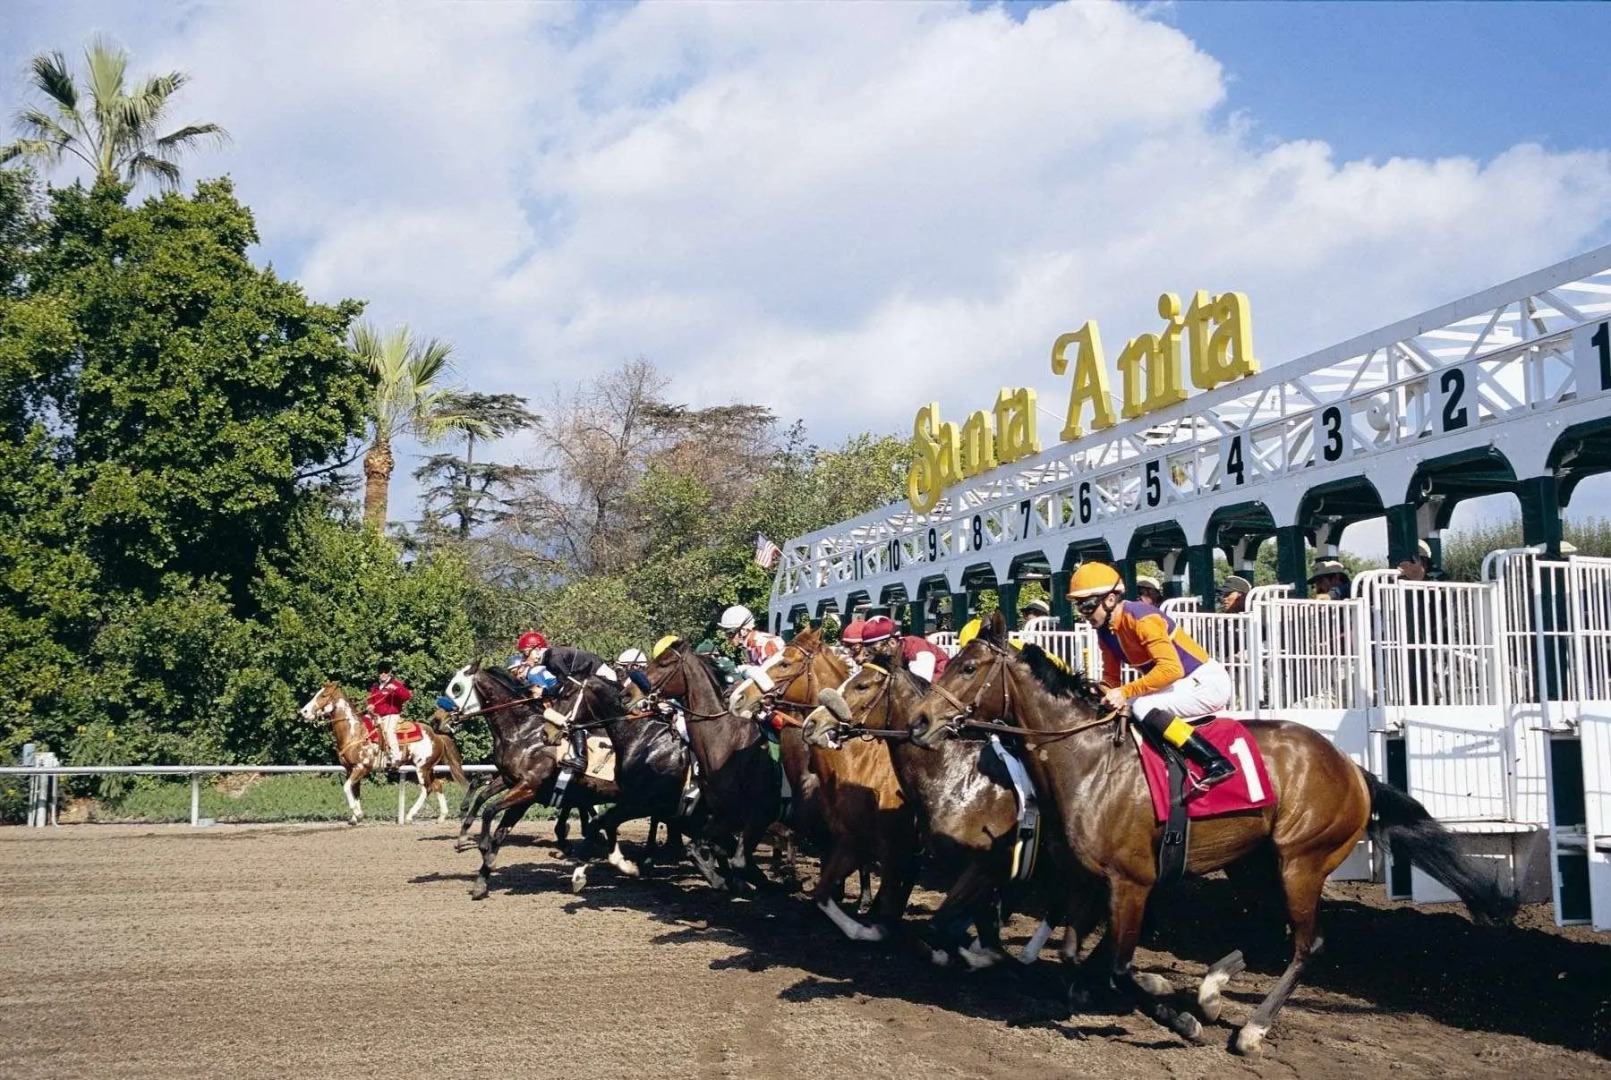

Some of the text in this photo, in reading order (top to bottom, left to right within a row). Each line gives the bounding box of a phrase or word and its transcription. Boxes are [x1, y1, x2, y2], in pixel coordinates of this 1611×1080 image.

[1591, 322, 1611, 391] 1
[908, 289, 1260, 514] Santa Anita
[1441, 368, 1468, 432] 2
[1322, 406, 1343, 462] 3
[1146, 460, 1160, 507] 5
[1226, 435, 1244, 485] 4
[1020, 500, 1031, 539] 7
[1079, 481, 1092, 524] 6
[887, 538, 900, 572] 10
[928, 528, 937, 562] 9
[973, 514, 982, 551] 8
[853, 550, 864, 580] 11
[1229, 737, 1266, 803] 1
